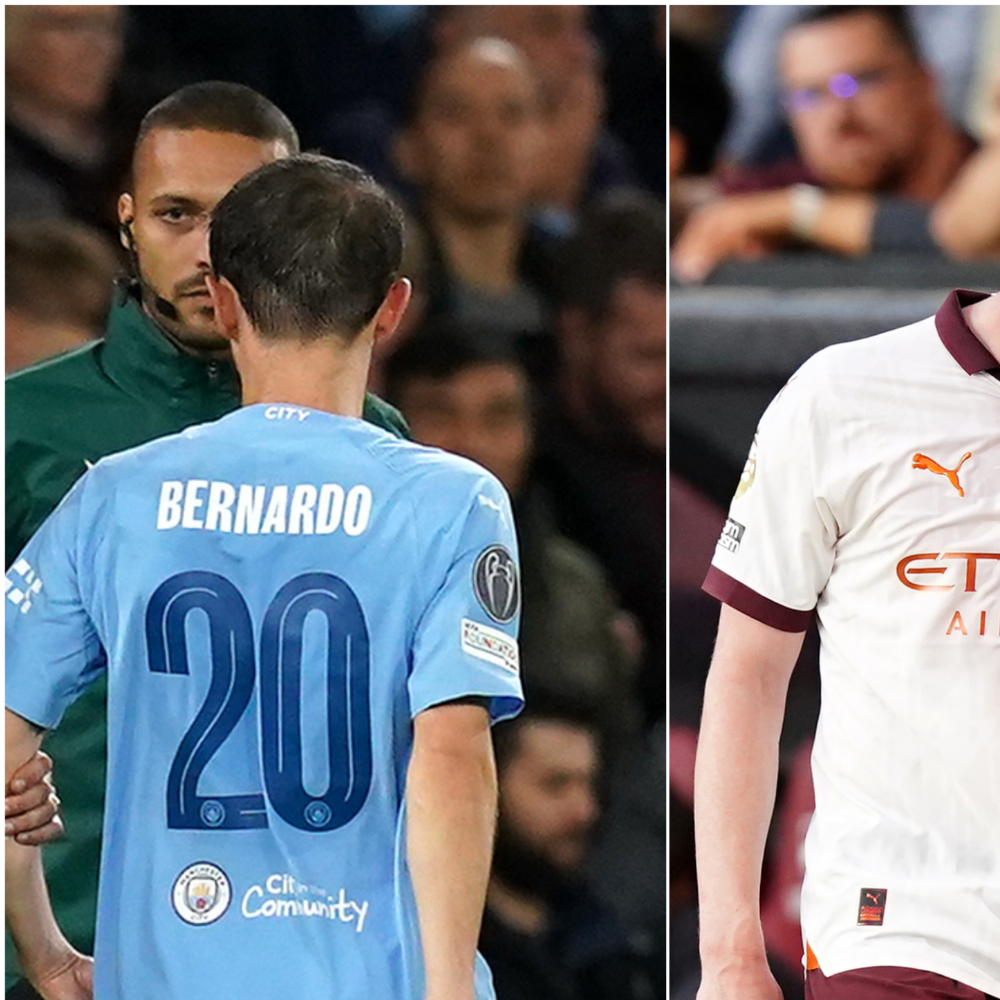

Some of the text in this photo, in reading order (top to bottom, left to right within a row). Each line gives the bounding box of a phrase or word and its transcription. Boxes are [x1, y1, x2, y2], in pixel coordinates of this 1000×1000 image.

[265, 407, 310, 421] CITY
[156, 479, 373, 536] BERNARDO
[145, 570, 374, 833] 20
